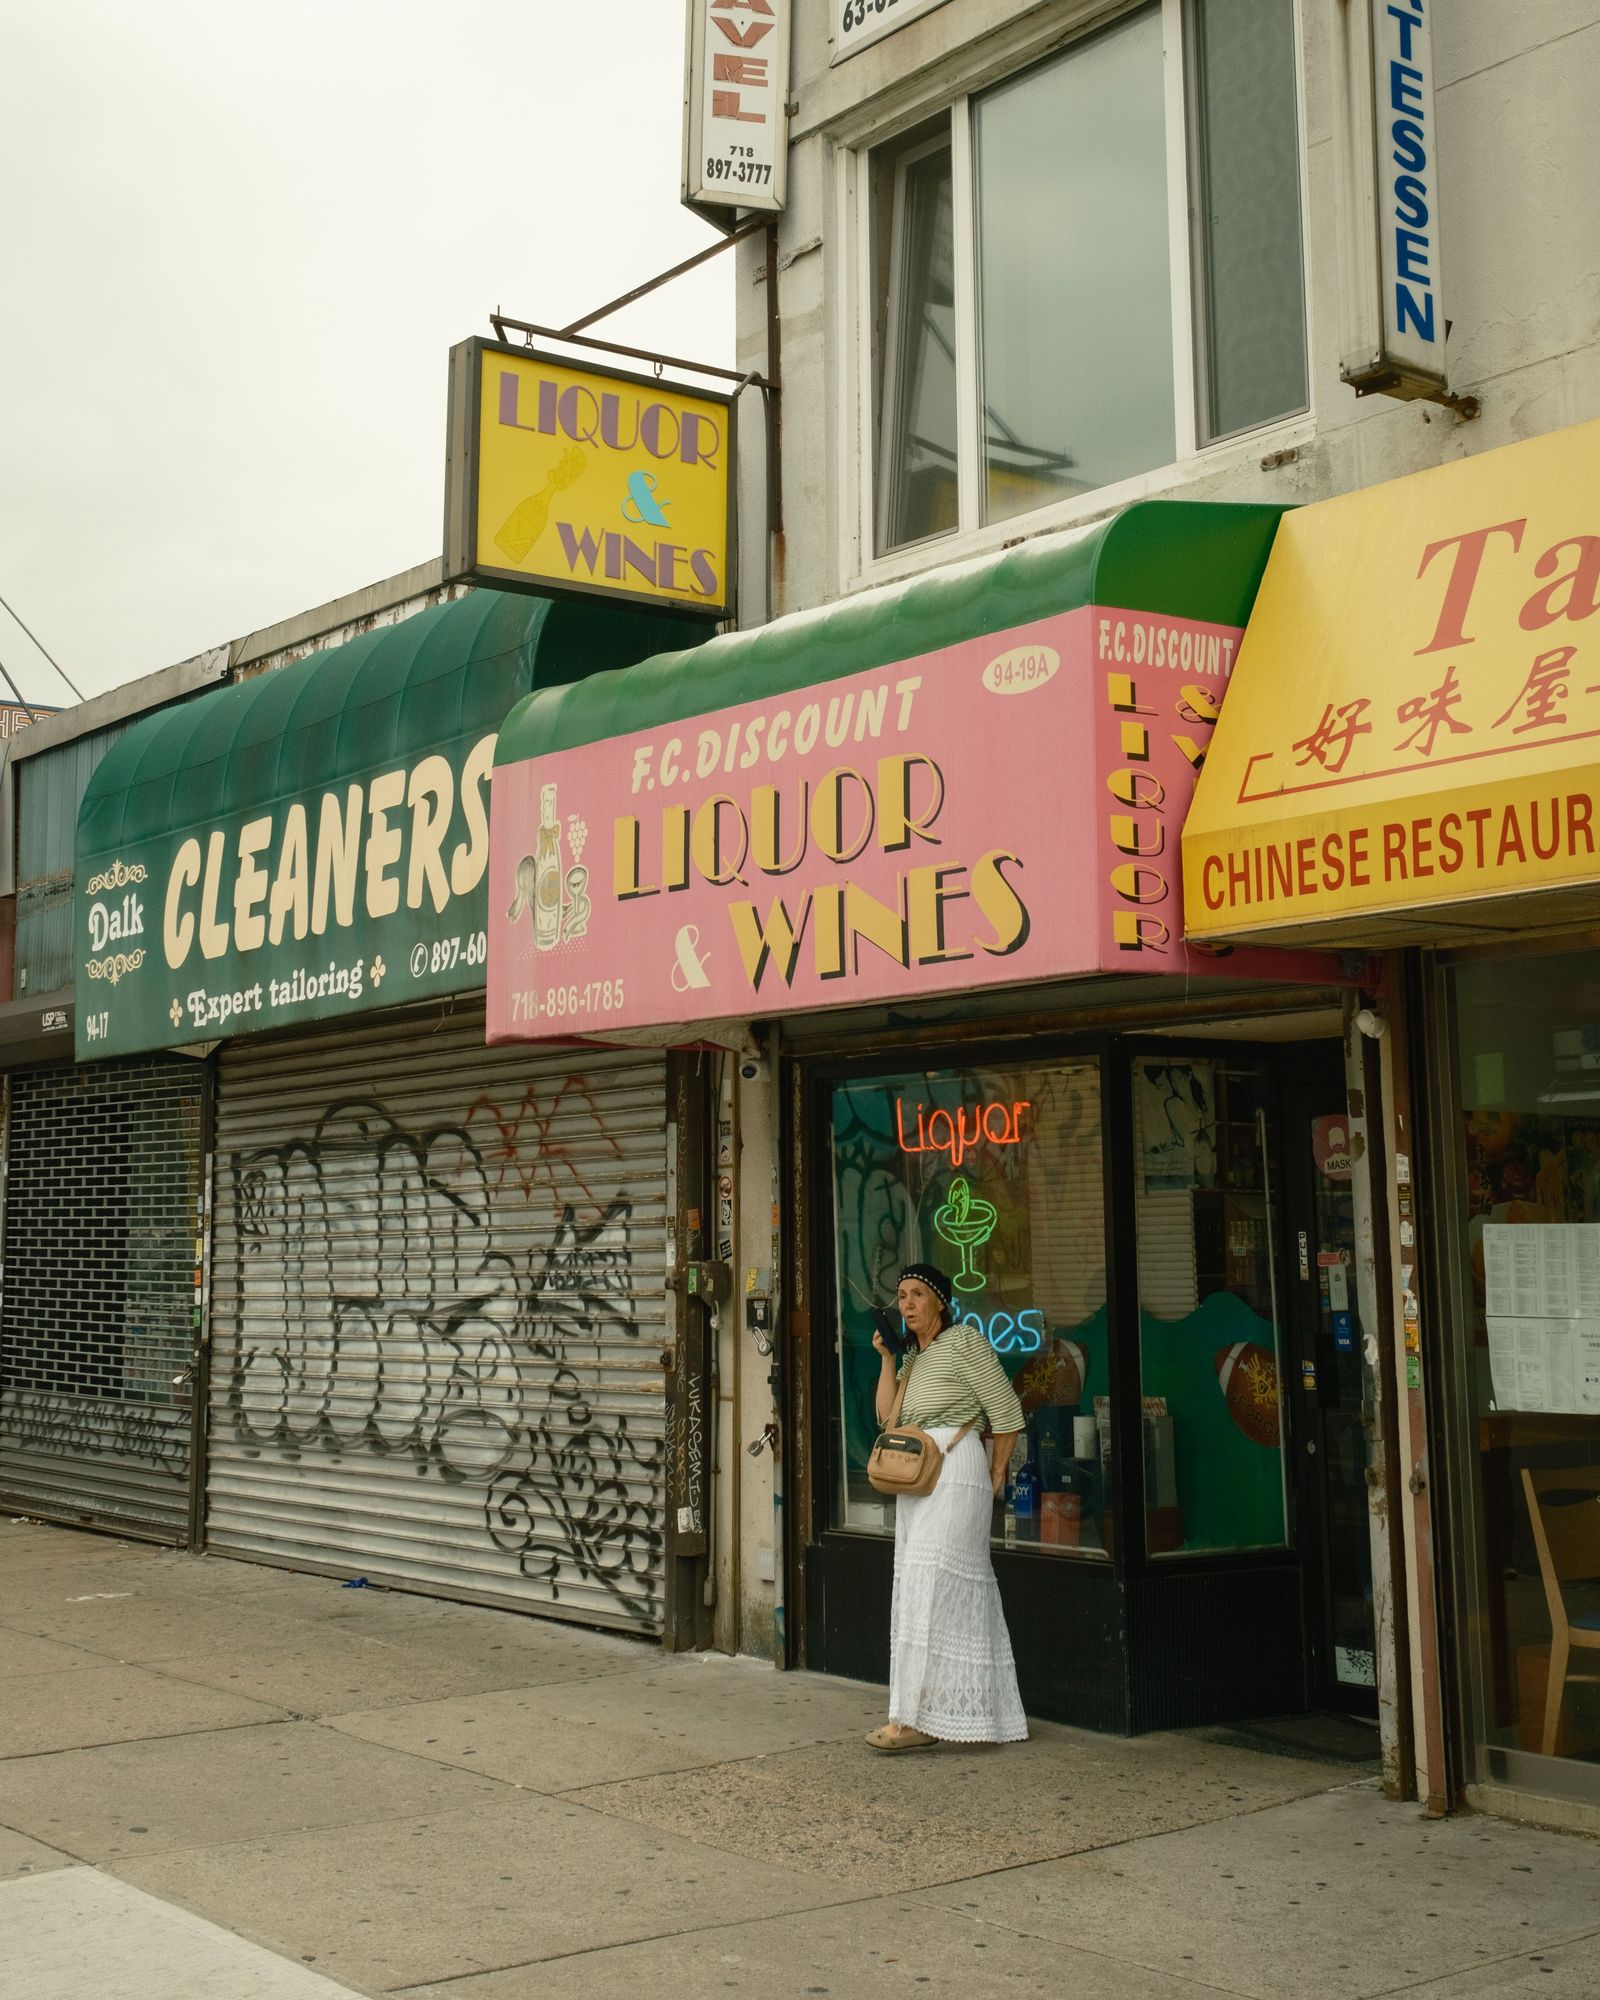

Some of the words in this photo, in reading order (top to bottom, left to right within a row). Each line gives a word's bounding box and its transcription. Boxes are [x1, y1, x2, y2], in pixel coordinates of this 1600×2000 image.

[706, 158, 772, 185] 897-3777
[729, 145, 755, 158] 718
[1386, 0, 1436, 343] TESSEN
[498, 371, 720, 471] LIQUOR
[621, 470, 671, 528] &
[556, 521, 718, 596] WINES
[992, 652, 1049, 688] 94-19A
[613, 752, 945, 901] LIQUOR
[1107, 672, 1170, 954] LIQUOR
[163, 733, 499, 969] CLEANERS
[1202, 828, 1370, 911] CHINESE
[1384, 793, 1600, 892] RESTAUR
[430, 930, 487, 974] 897-60
[727, 848, 1031, 993] WINES
[671, 924, 712, 993] &
[187, 983, 263, 1028] Expert
[269, 959, 364, 1005] tailoring
[511, 978, 625, 1022] 718-896-1785
[896, 1097, 1031, 1166] Liquor
[1327, 1159, 1351, 1171] MASK
[1299, 1232, 1307, 1267] PULL
